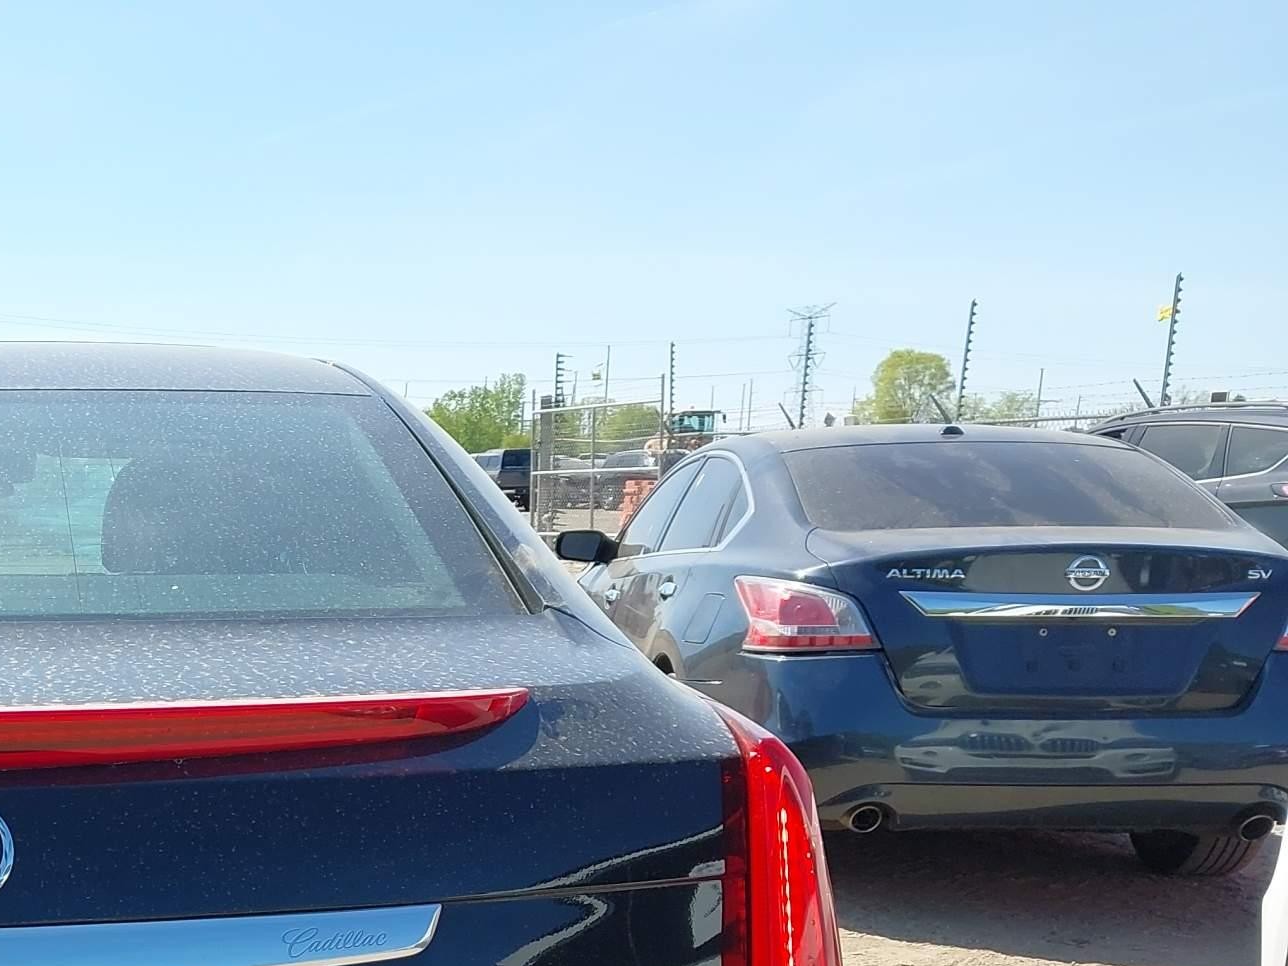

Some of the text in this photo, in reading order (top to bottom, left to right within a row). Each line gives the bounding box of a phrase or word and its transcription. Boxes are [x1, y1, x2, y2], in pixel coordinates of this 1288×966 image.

[886, 568, 966, 579] ALTIMA
[1247, 569, 1273, 579] SV
[281, 927, 388, 958] Cadillac
